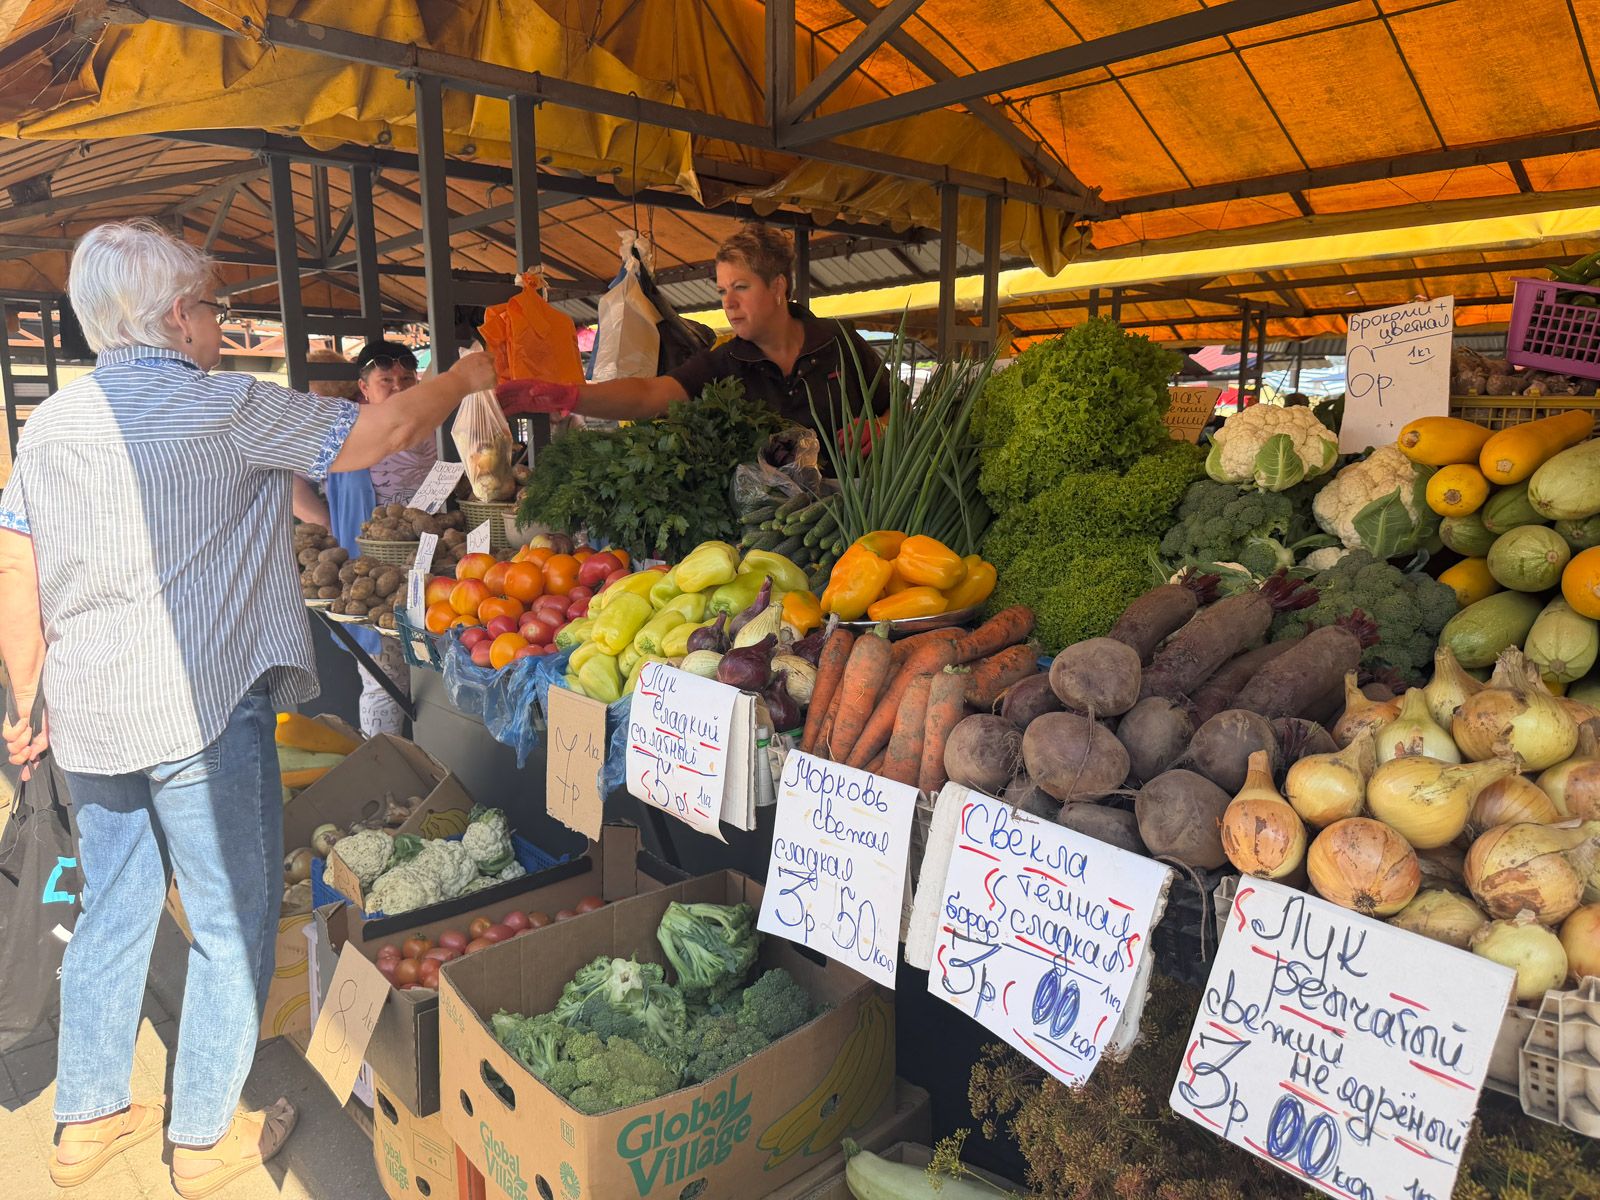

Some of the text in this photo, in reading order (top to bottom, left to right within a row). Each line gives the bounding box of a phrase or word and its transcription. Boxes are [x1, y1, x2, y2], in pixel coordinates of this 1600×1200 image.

[1408, 346, 1431, 358] 1кг
[643, 664, 677, 704] Лук
[784, 755, 888, 814] Морковь
[812, 798, 890, 856] свежая
[966, 803, 1089, 883] Свекла
[1251, 896, 1368, 996] Лук
[1289, 1052, 1330, 1094] не
[617, 1072, 743, 1159] Global
[480, 1121, 520, 1178] Global
[627, 1114, 753, 1198] Village
